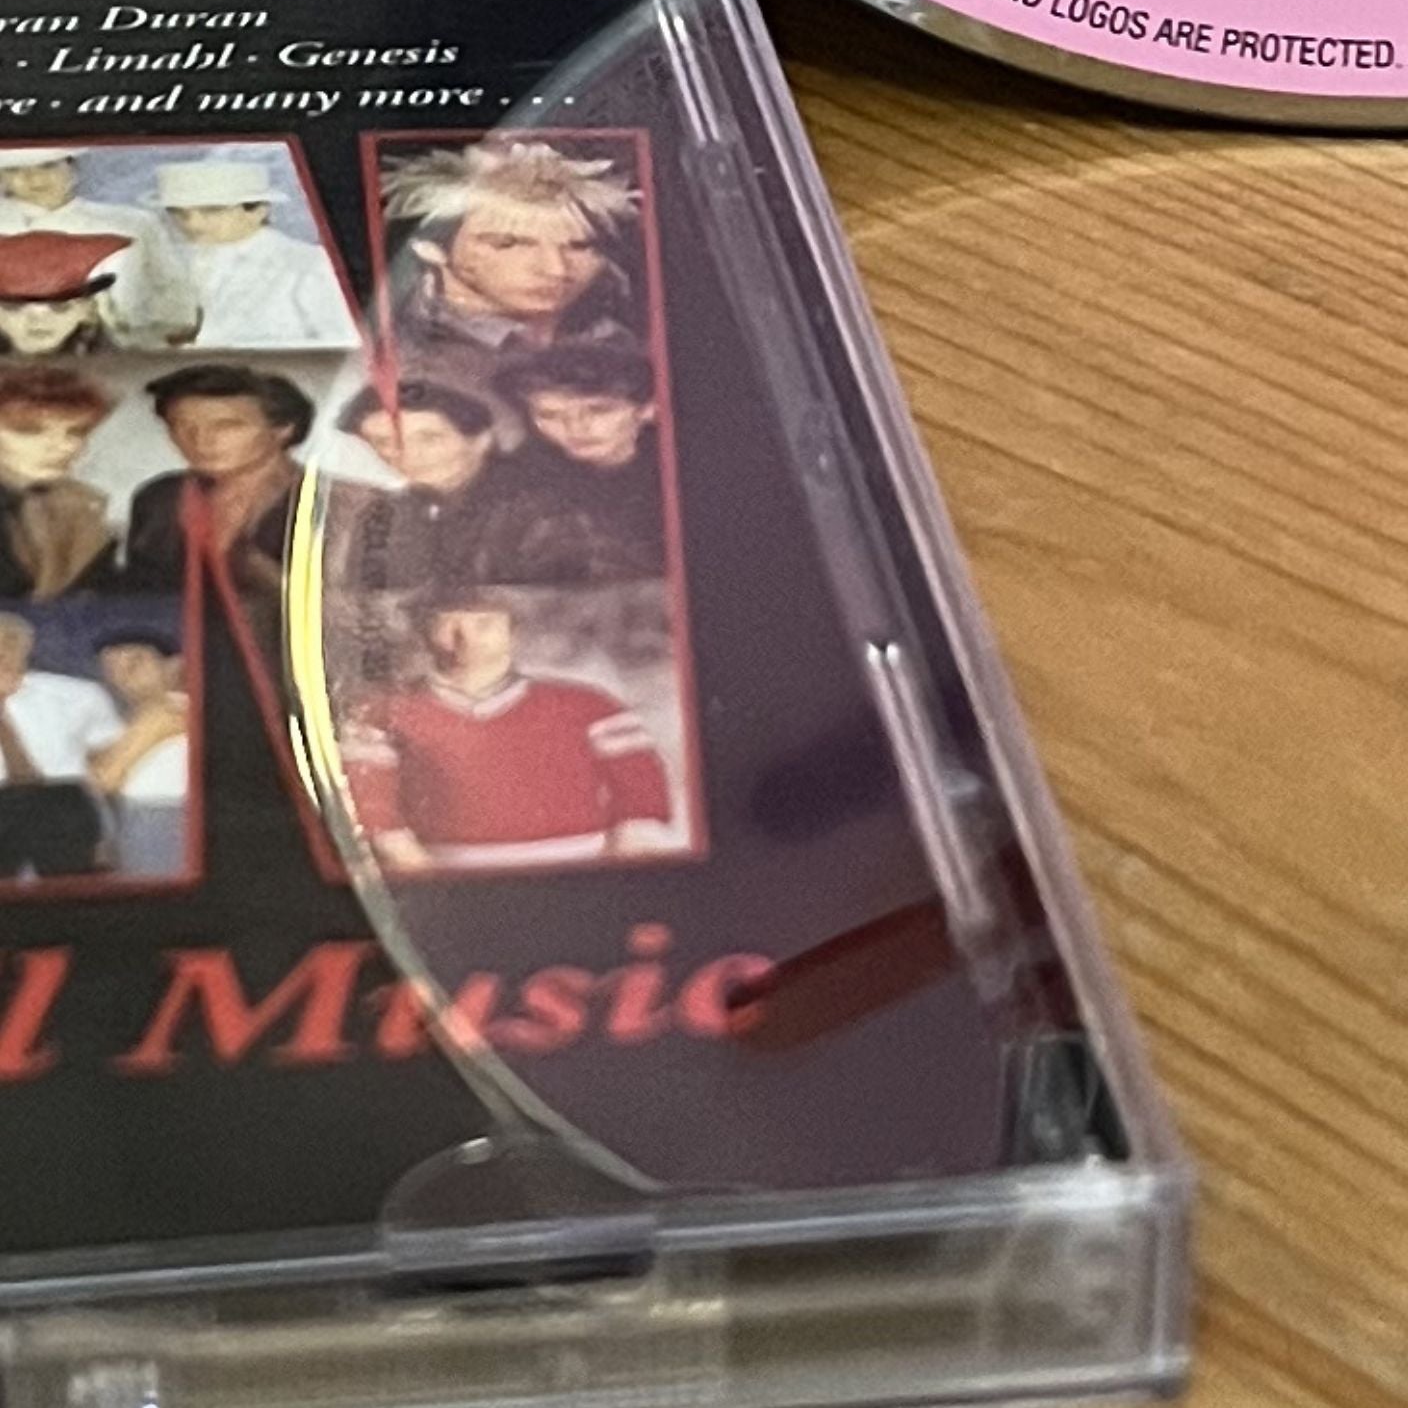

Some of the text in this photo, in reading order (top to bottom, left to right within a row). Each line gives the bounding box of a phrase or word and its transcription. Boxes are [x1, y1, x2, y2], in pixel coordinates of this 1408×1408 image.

[99, 5, 269, 32] Duran
[47, 39, 460, 73] Limahl Genesis
[1152, 17, 1215, 54] ARE
[1220, 28, 1403, 70] PROTECTED.
[77, 84, 184, 114] and
[198, 88, 342, 117] many
[357, 83, 485, 108] more
[109, 923, 778, 1078] Music
